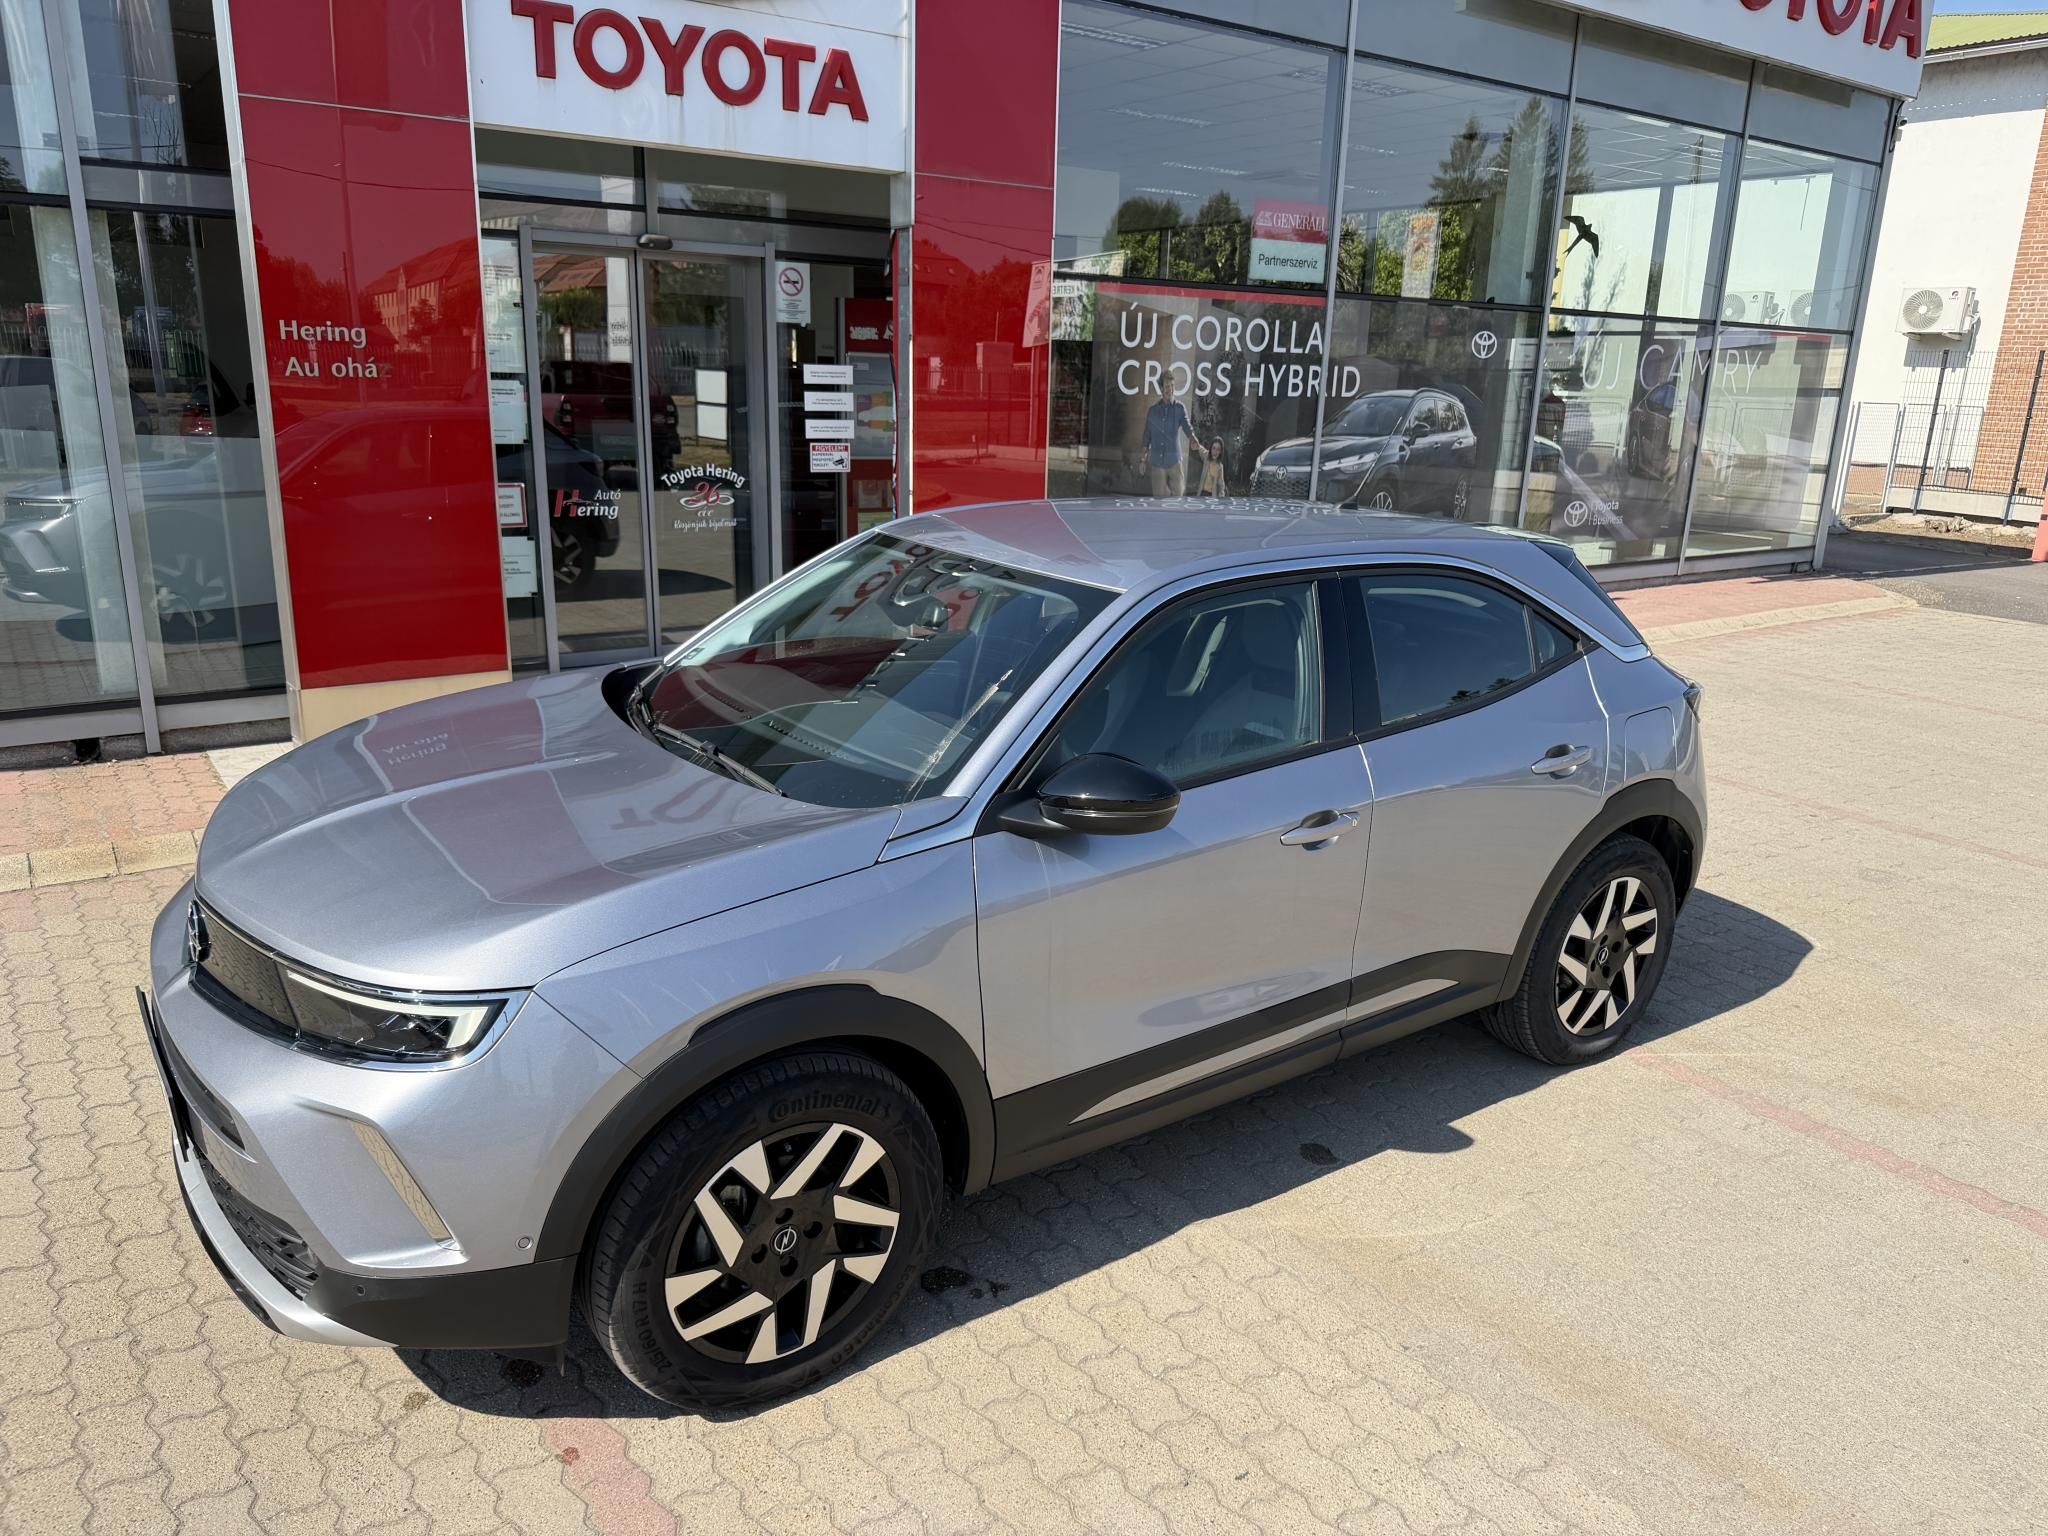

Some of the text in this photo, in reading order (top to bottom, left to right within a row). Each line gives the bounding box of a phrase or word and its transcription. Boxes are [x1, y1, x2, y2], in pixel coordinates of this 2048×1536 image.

[511, 0, 869, 122] TOYOTA
[1273, 212, 1325, 231] GENERALI
[1258, 253, 1318, 269] Partnerszerviz
[279, 319, 367, 349] Hering
[1120, 302, 1324, 354] ÚJ COROLLA
[285, 356, 320, 377] Au
[1117, 359, 1361, 398] CROSS HYBRID
[1640, 337, 1762, 394] CAMRY
[661, 463, 746, 488] Toyota Hering
[553, 489, 619, 519] Hering
[594, 488, 622, 501] Autó
[687, 481, 723, 506] 26
[768, 1090, 881, 1123] Continental
